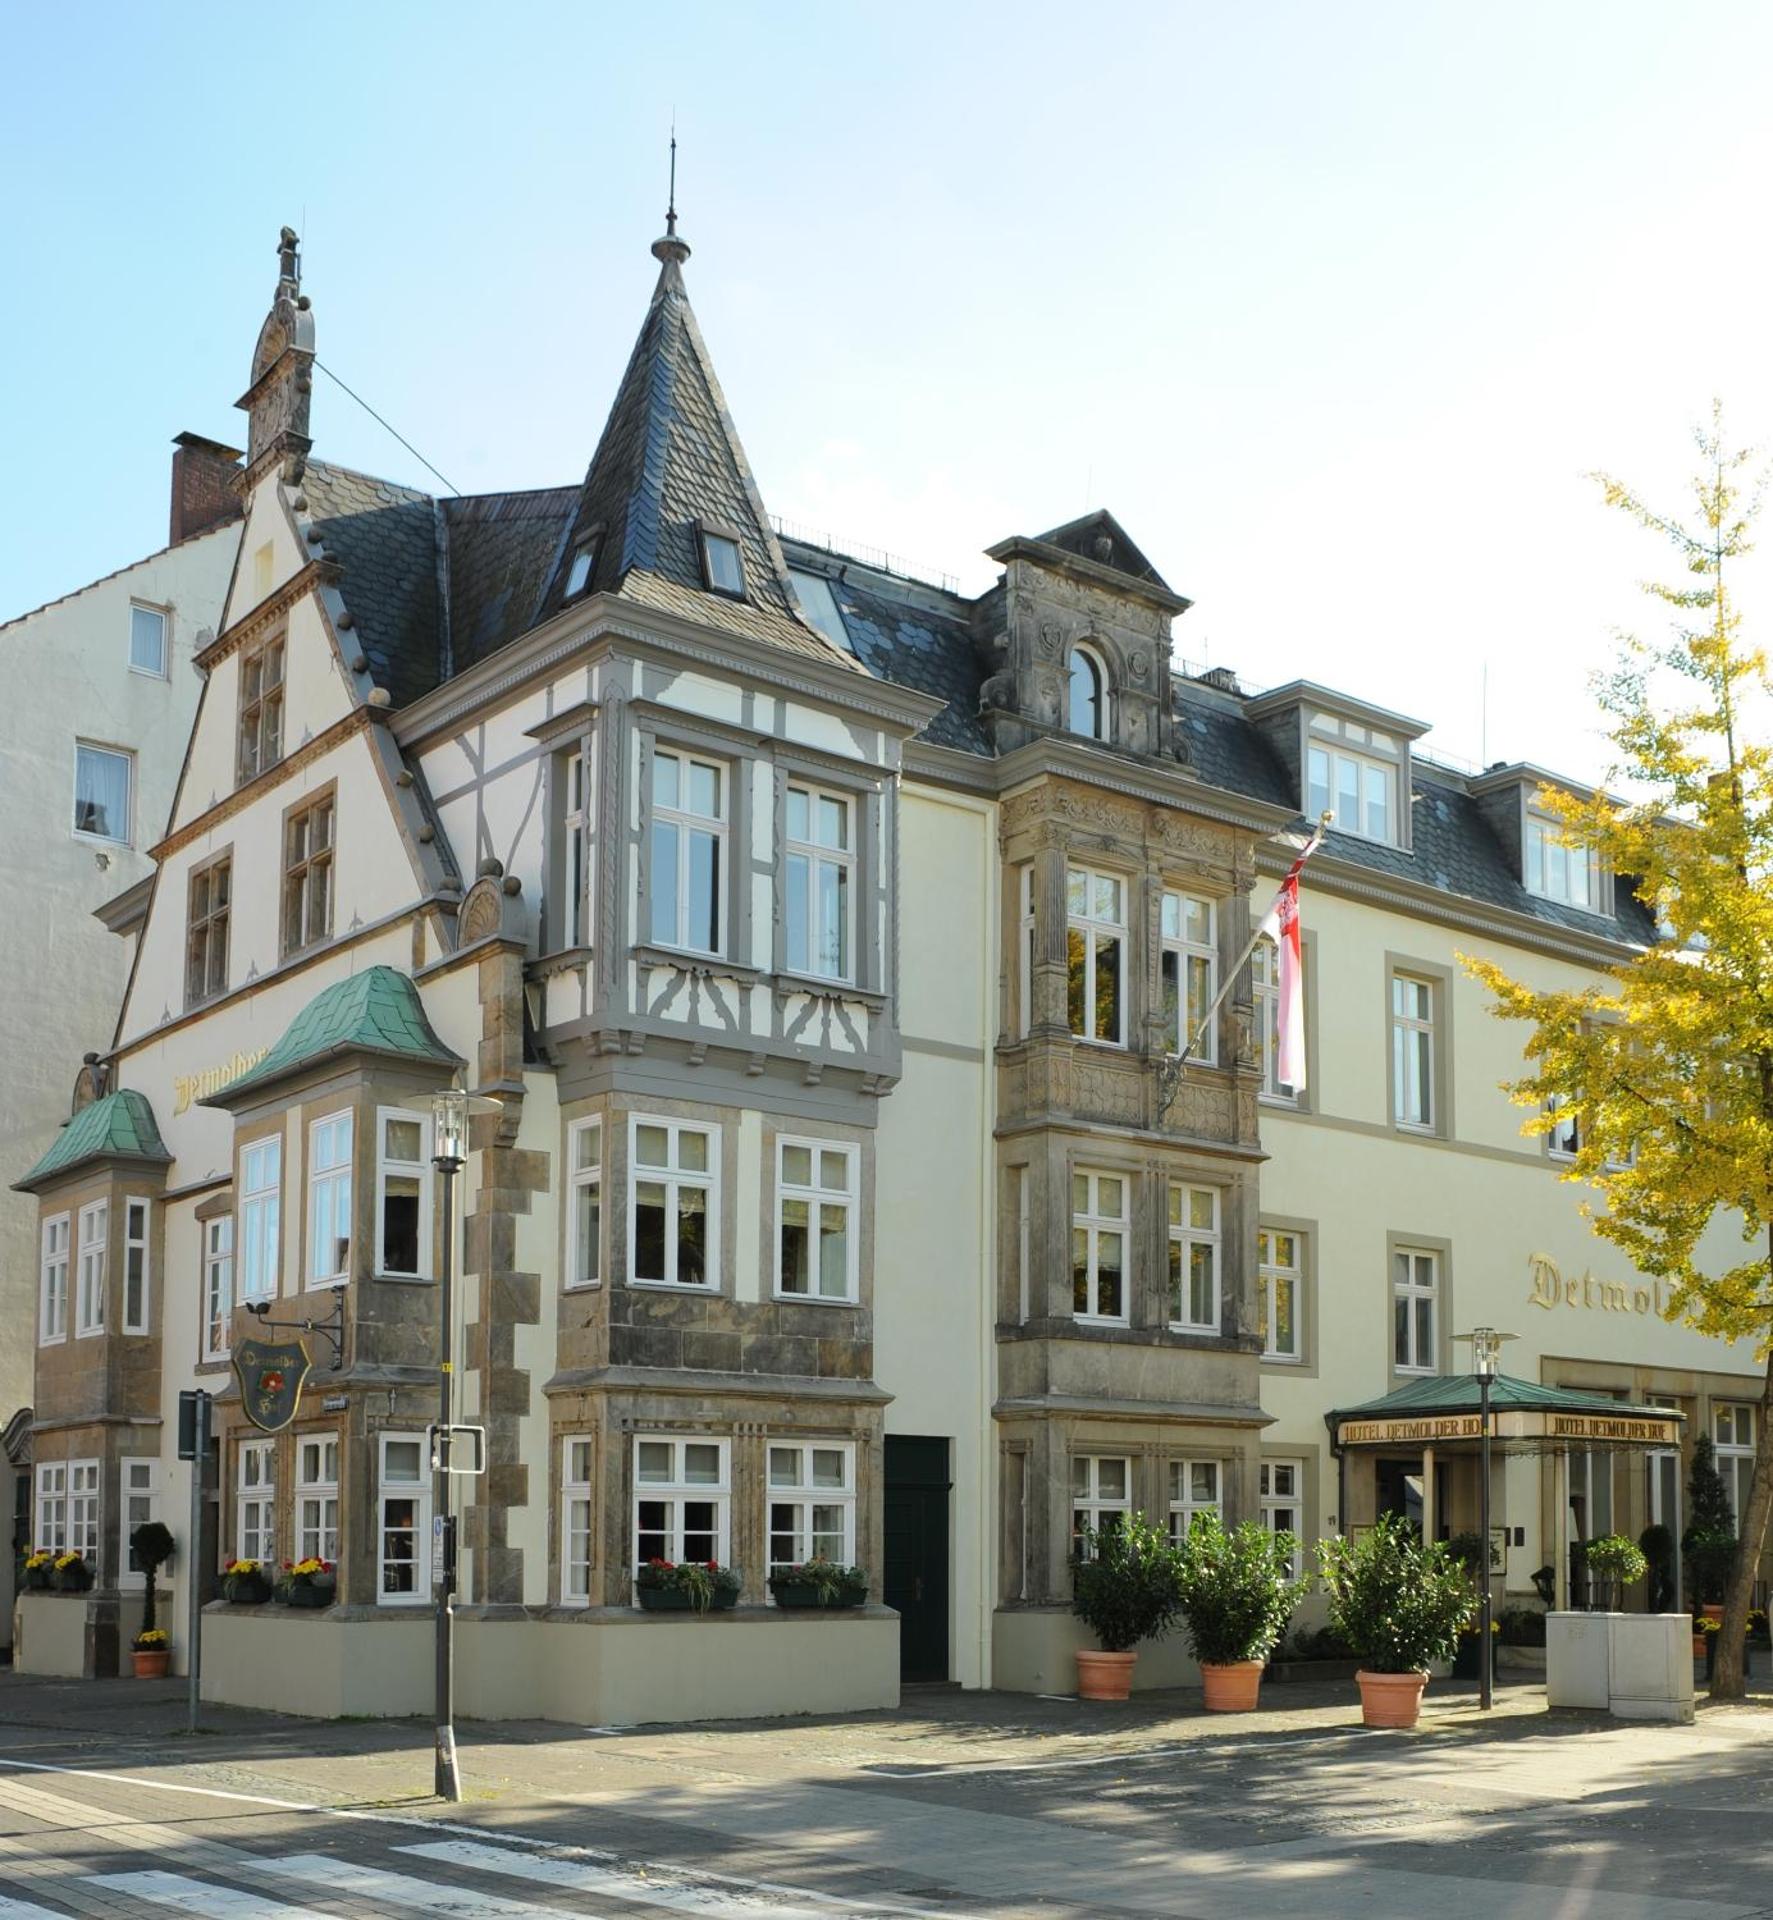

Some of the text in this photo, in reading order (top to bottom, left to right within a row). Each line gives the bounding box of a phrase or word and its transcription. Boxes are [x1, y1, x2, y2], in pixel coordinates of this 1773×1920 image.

[1345, 1417, 1483, 1442] HOTEL DETMOLDER HO
[1554, 1417, 1585, 1435] HOTEL
[1590, 1419, 1646, 1438] DETMOLDER
